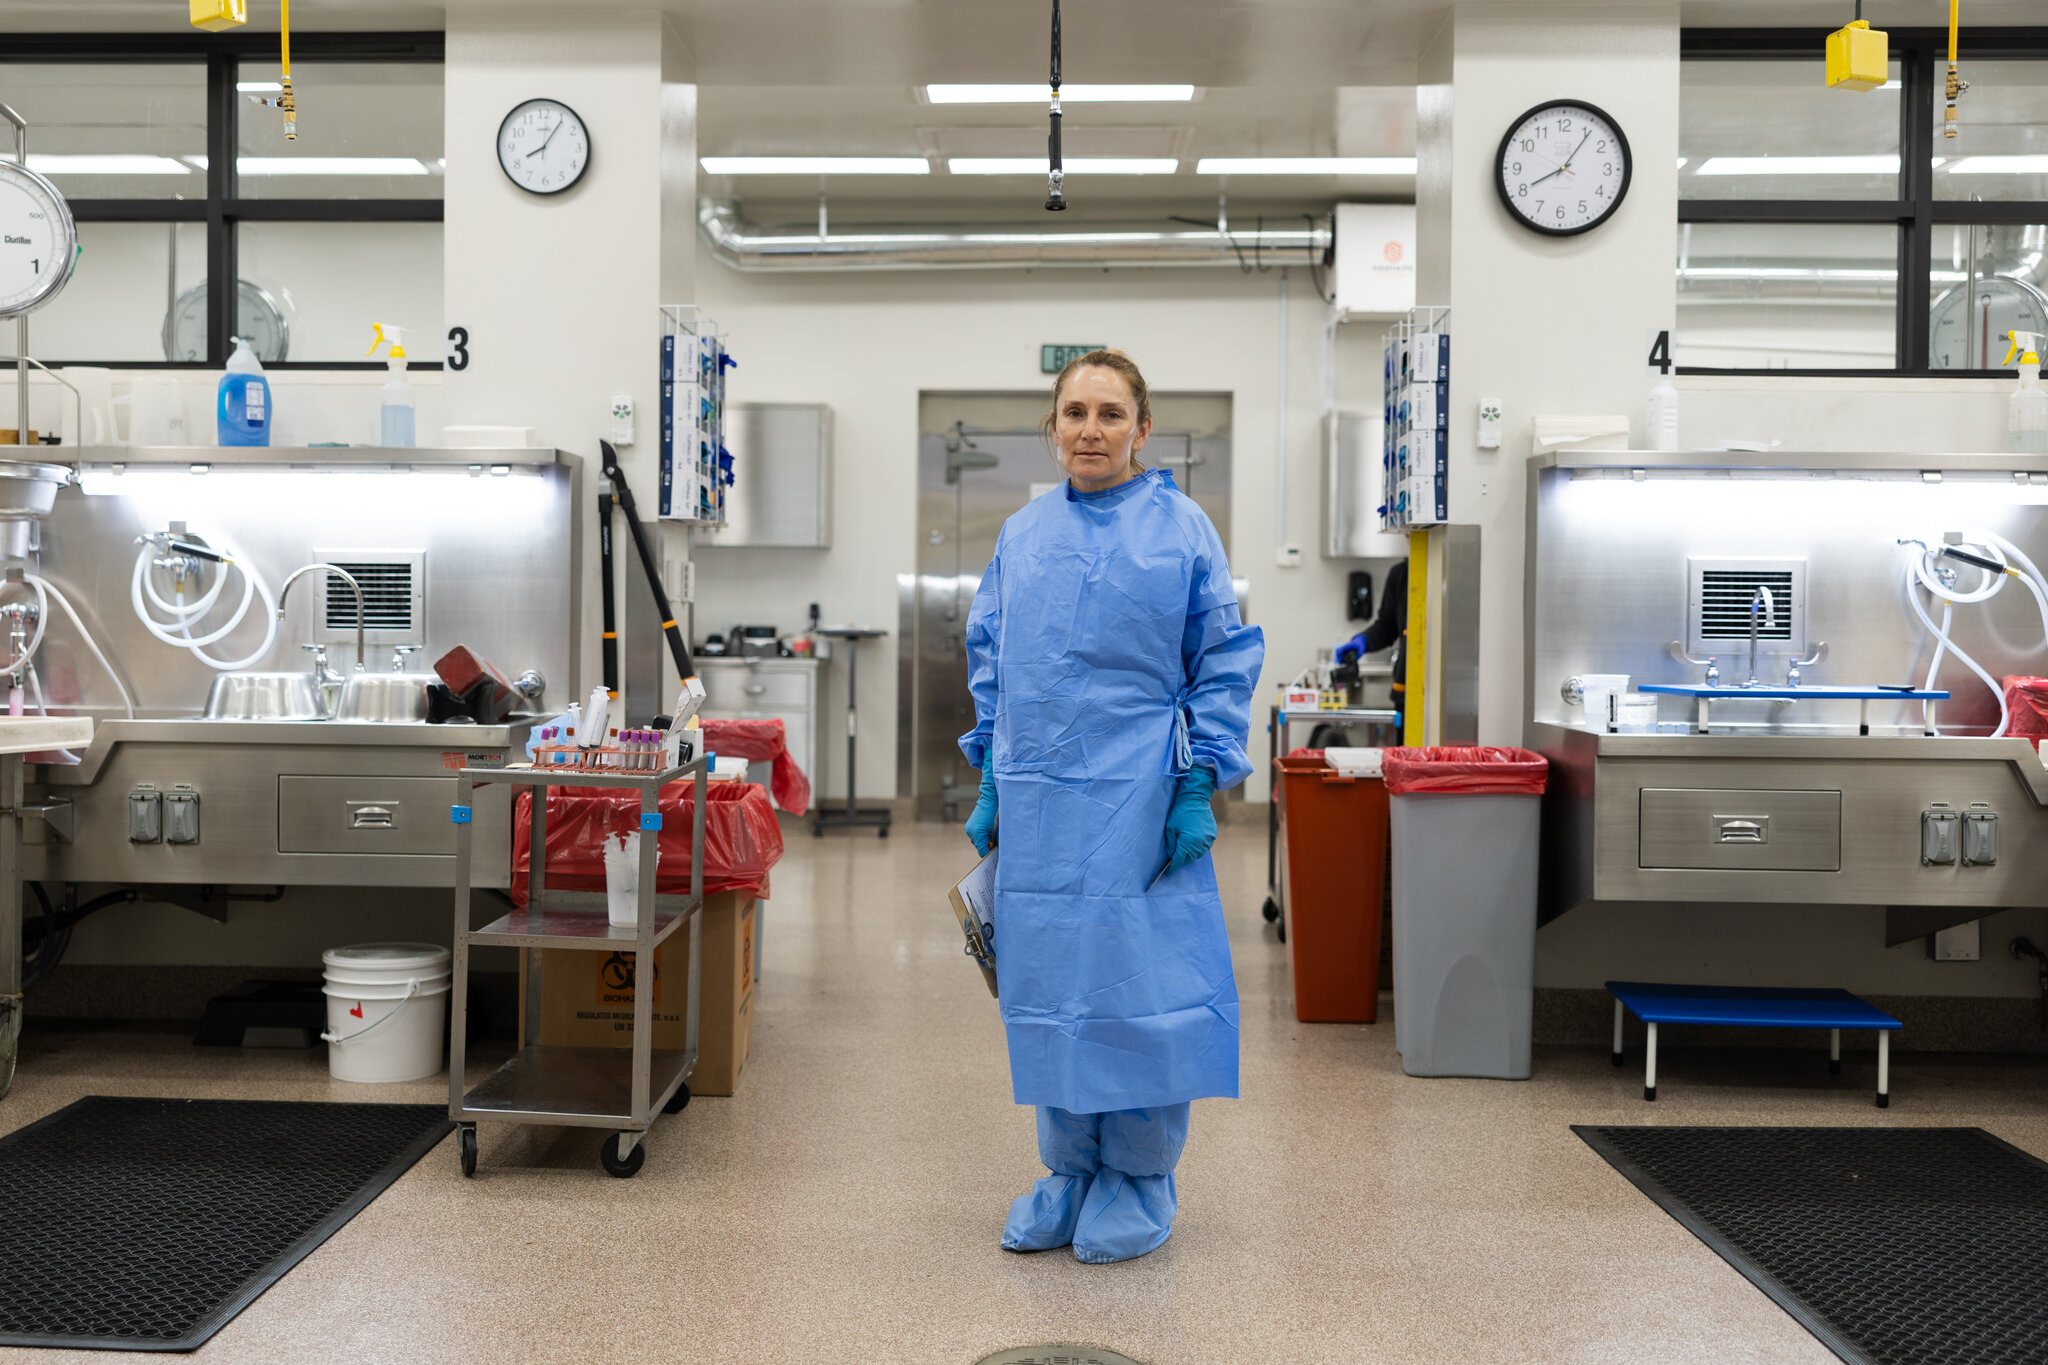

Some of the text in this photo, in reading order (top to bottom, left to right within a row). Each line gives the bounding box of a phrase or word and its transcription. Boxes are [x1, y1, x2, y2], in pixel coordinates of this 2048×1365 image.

[523, 114, 533, 125] 11
[538, 108, 551, 119] 12
[560, 113, 563, 123] 1
[570, 125, 577, 136] 2
[1557, 118, 1571, 132] 12
[512, 127, 525, 138] 10
[1535, 126, 1547, 139] 11
[1582, 126, 1588, 139] 1
[508, 143, 515, 152] 9
[575, 143, 582, 153] 3
[1520, 139, 1535, 153] 10
[1596, 140, 1606, 154] 2
[513, 159, 521, 169] 8
[570, 160, 577, 170] 4
[1512, 162, 1522, 176] 9
[1602, 162, 1612, 176] 3
[526, 170, 533, 181] 7
[542, 176, 549, 186] 6
[558, 171, 565, 181] 5
[1518, 183, 1528, 197] 8
[1595, 184, 1604, 197] 4
[1535, 200, 1545, 213] 7
[1556, 205, 1565, 219] 6
[1578, 200, 1587, 214] 5
[31, 259, 39, 274] 1
[448, 327, 469, 370] 3
[1648, 331, 1672, 375] 4
[1942, 354, 1949, 366] 1
[612, 1012, 635, 1021] MEDICA
[614, 1022, 625, 1031] UN
